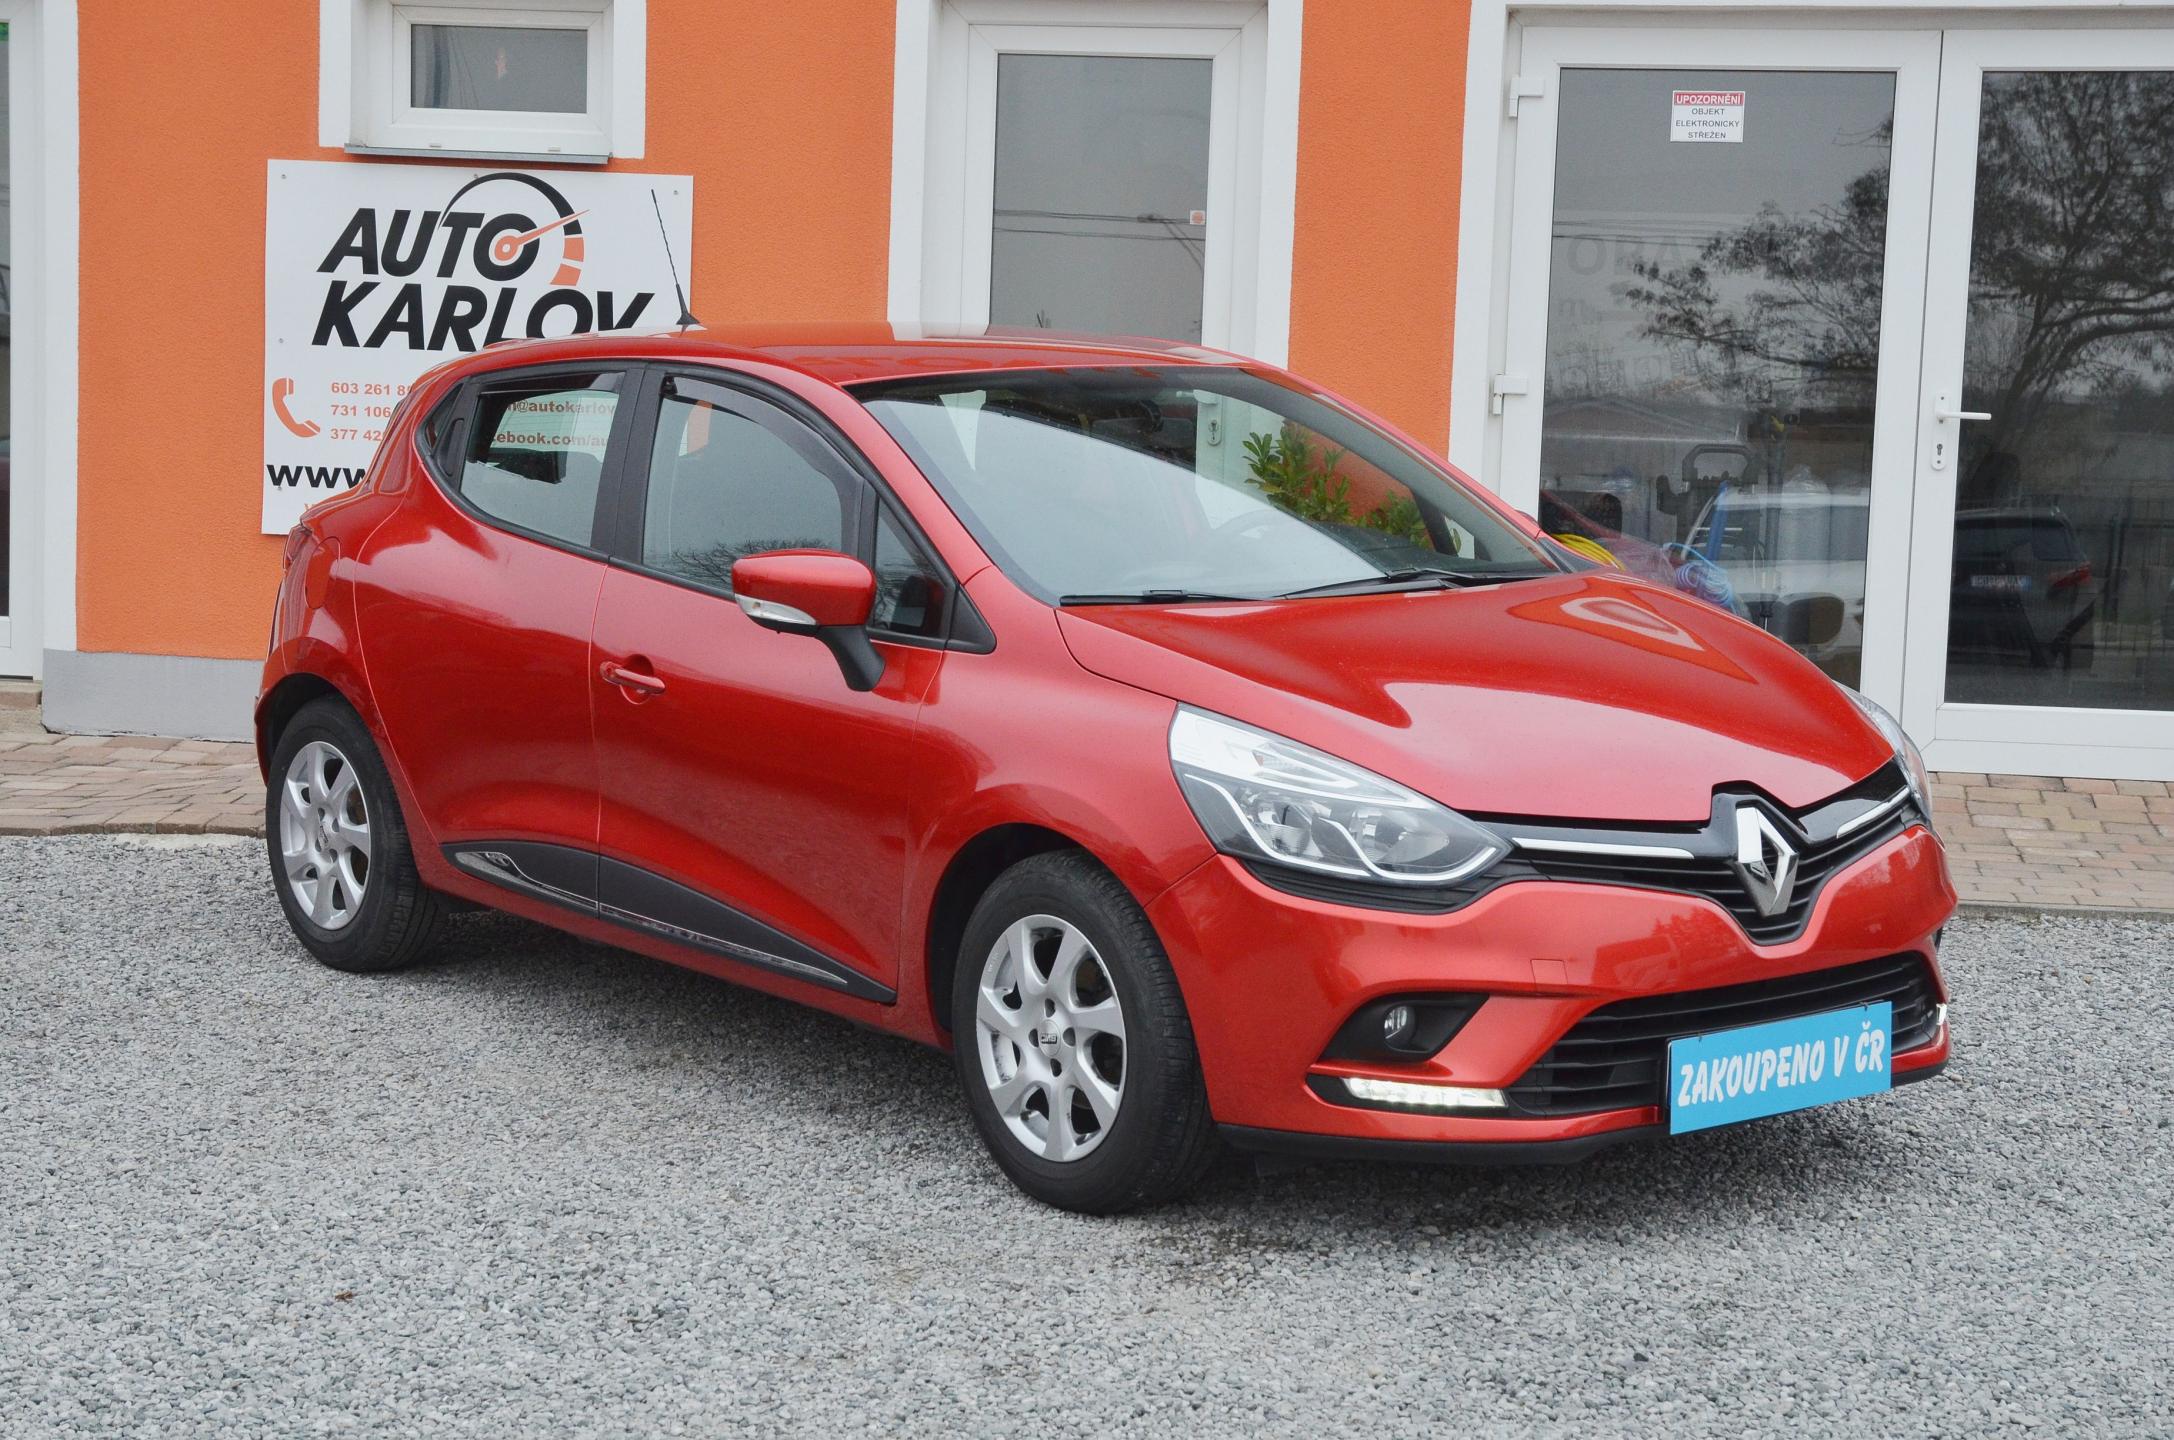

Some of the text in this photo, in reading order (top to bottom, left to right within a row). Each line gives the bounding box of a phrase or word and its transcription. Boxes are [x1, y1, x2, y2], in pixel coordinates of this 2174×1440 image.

[1691, 108, 1725, 116] OBJEKT
[1675, 120, 1740, 128] ELEKTRONICKY
[1688, 131, 1727, 139] STŘEŽEN
[316, 207, 541, 282] AUTO
[311, 280, 656, 352] KARLOV
[331, 382, 359, 394] 603
[364, 383, 391, 396] 261
[330, 404, 391, 418] 731 106
[330, 428, 385, 442] 377 42
[1678, 1020, 1885, 1107] ZAKOUPENO V ČR
